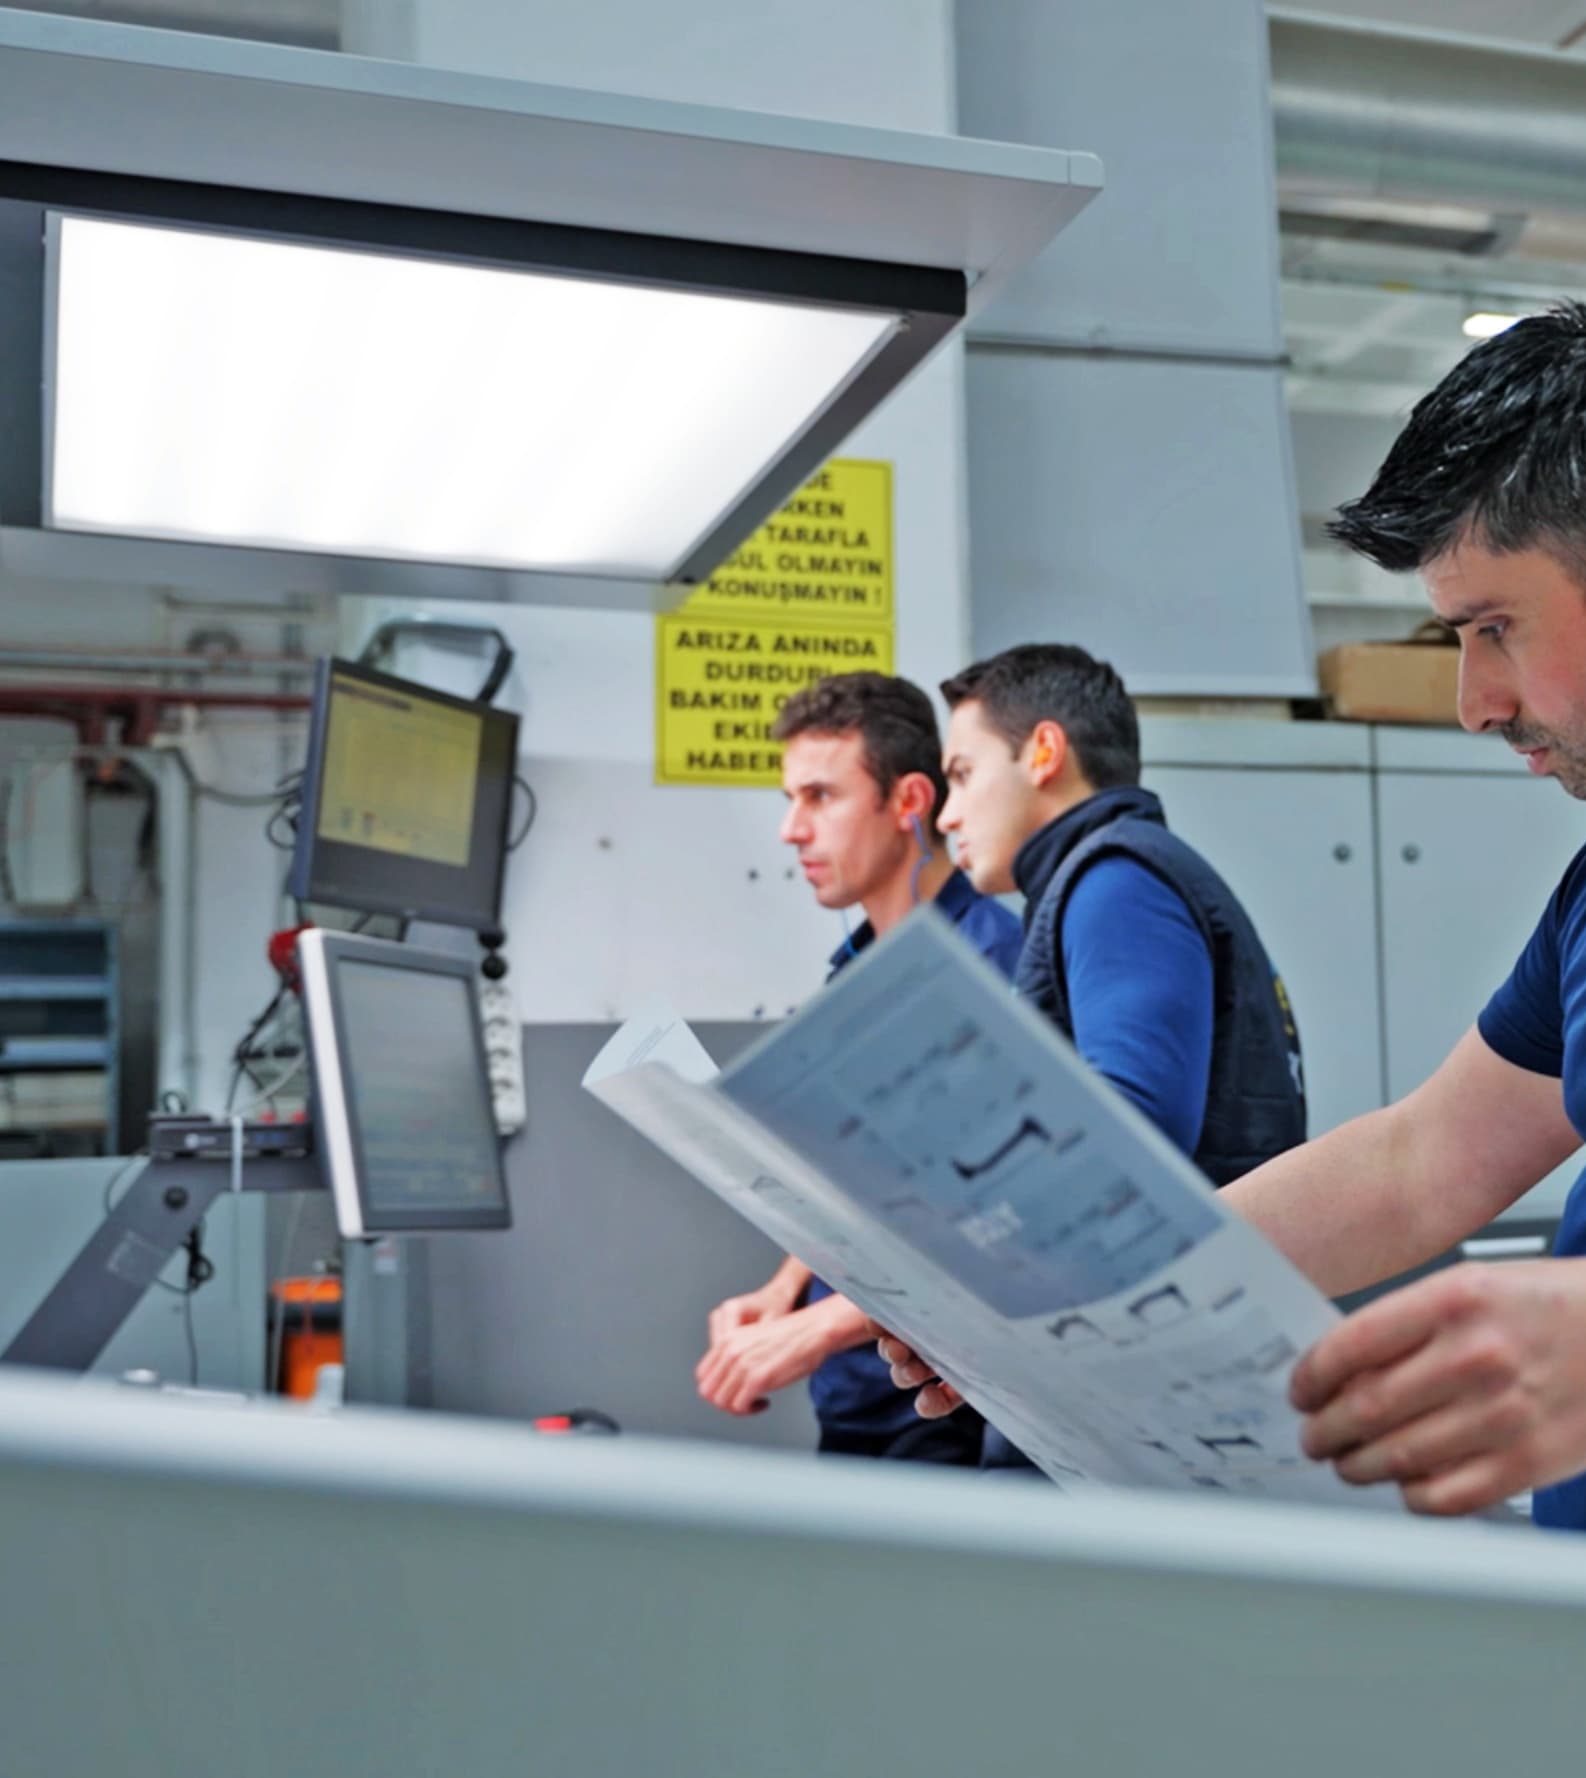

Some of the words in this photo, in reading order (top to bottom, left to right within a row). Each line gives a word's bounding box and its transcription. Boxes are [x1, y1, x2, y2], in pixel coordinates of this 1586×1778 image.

[766, 523, 870, 549] TARAFLA
[777, 554, 882, 576] OLMAYIN
[708, 578, 867, 604] KONUŞMAYIN
[676, 630, 761, 652] ARIZA
[773, 634, 877, 657] ANINDA
[670, 690, 761, 711] BAKIM
